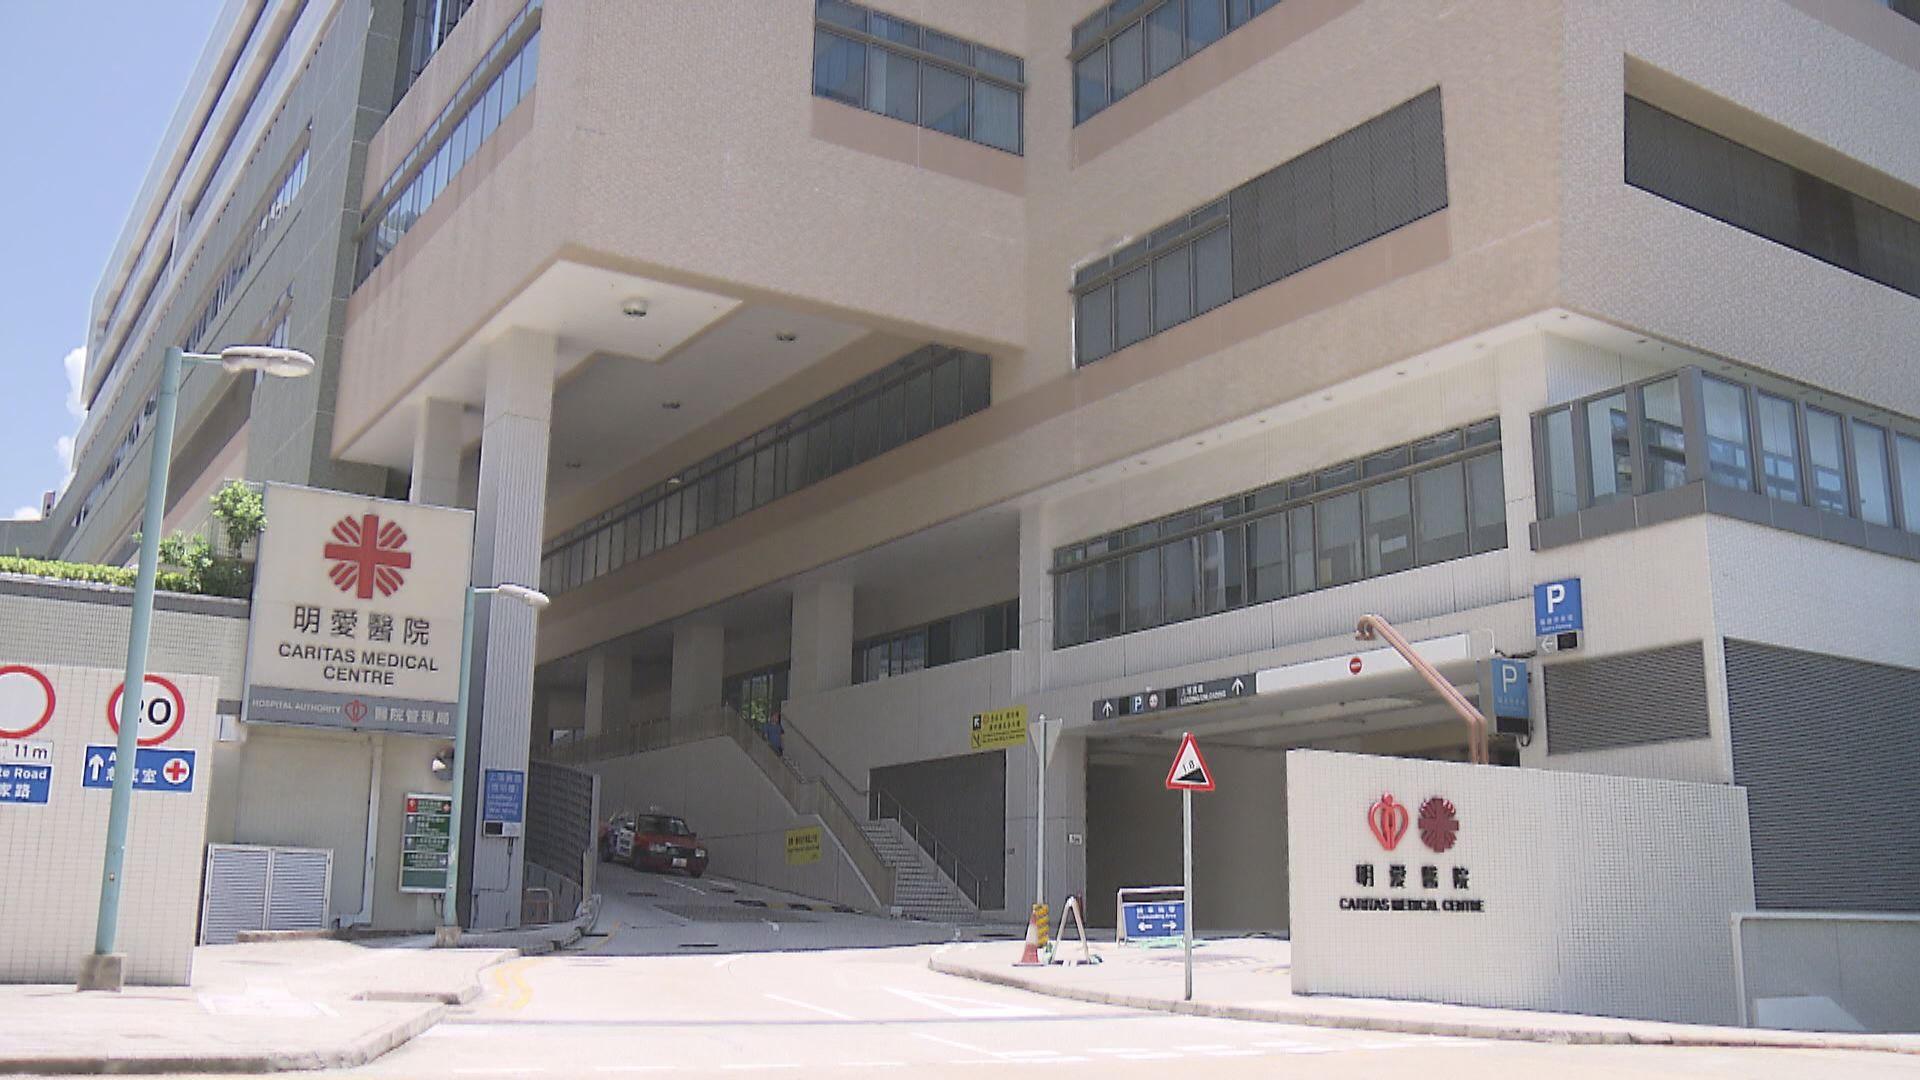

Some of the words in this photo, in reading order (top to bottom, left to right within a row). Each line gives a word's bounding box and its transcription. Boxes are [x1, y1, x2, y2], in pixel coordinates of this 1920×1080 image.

[1546, 584, 1565, 614] P
[293, 606, 430, 646] 明愛醫院
[278, 642, 356, 664] CARITAS
[361, 652, 439, 672] MEDICAL
[323, 666, 395, 686] CENTRE
[1502, 664, 1517, 694] P
[252, 698, 293, 710] HOSPITAL
[294, 702, 341, 714] AUTHORITY
[1134, 695, 1142, 713] P
[14, 767, 48, 779] Road
[1339, 898, 1390, 911] CARITAS
[1391, 899, 1440, 912] MEDICAL
[1441, 900, 1485, 912] CENTRE
